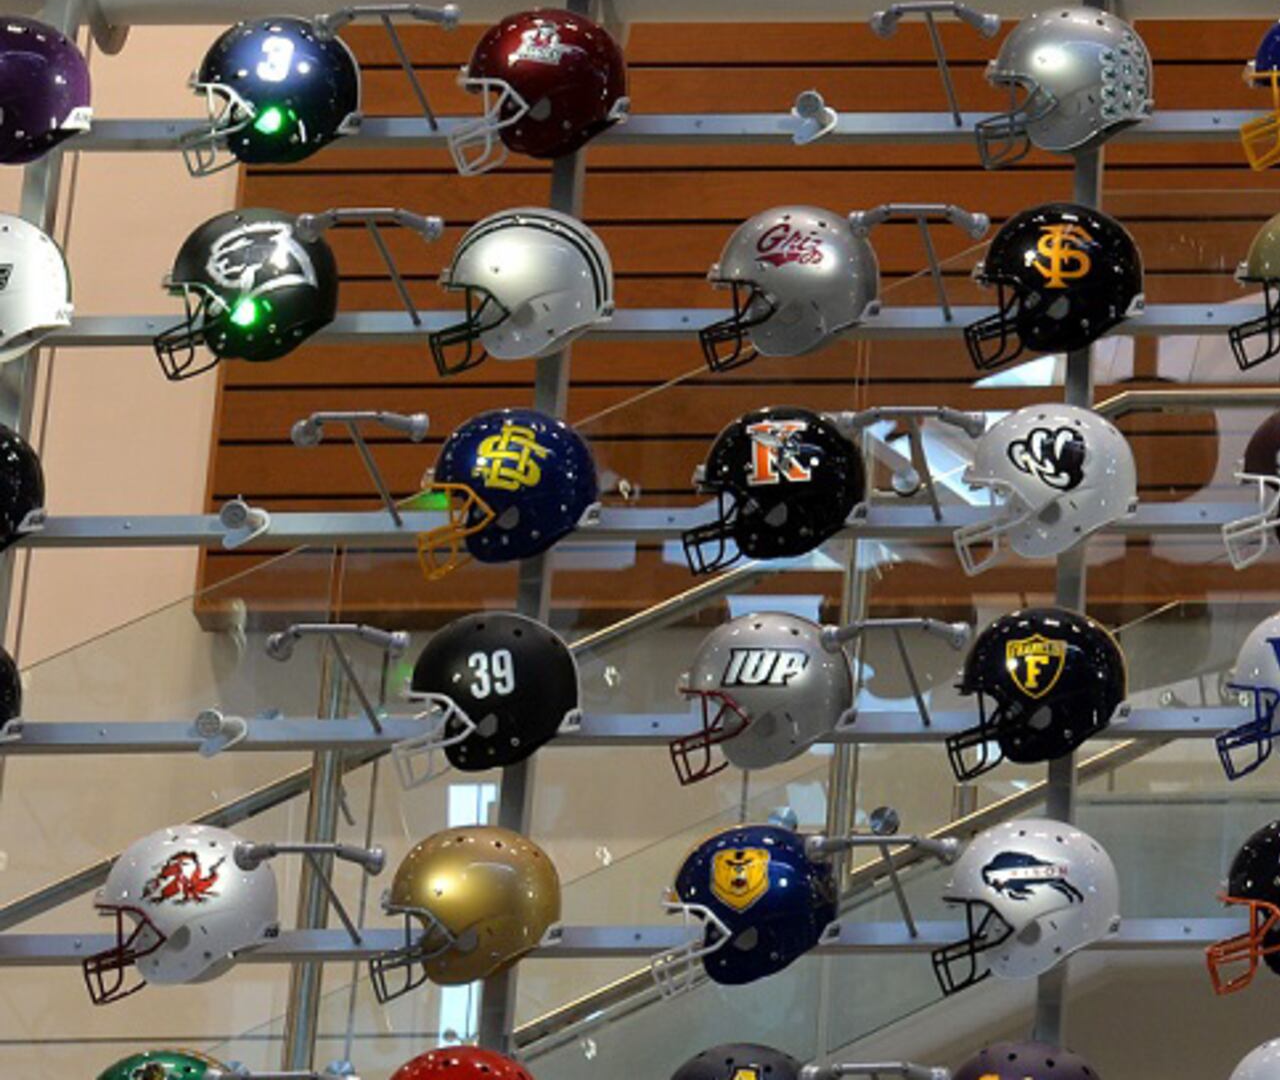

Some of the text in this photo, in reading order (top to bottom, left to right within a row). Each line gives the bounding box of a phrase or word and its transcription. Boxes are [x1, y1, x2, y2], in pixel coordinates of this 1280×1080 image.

[256, 38, 295, 81] 3
[747, 420, 809, 484] K
[467, 650, 514, 698] 39
[722, 648, 810, 686] IUP
[1026, 655, 1050, 687] F
